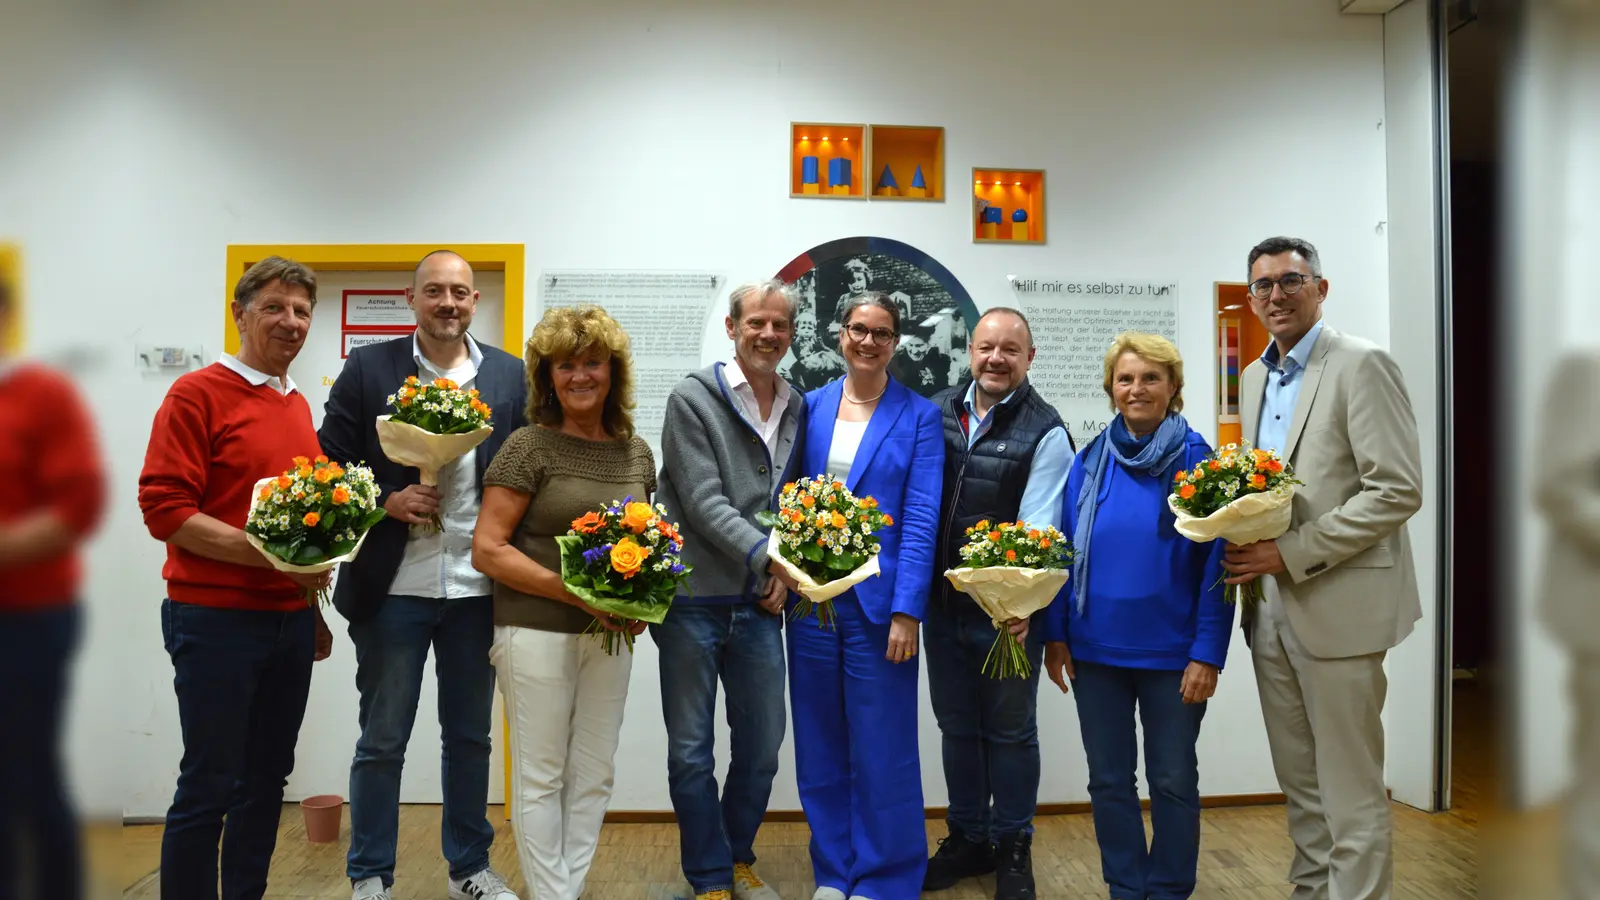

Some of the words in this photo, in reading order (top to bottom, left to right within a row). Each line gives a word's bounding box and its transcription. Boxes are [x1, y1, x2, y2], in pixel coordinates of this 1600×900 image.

[1041, 280, 1063, 293] mir
[1067, 283, 1082, 294] es
[1086, 281, 1124, 295] selbst
[1128, 284, 1143, 296] zu
[367, 298, 396, 306] Achtung
[1042, 307, 1072, 316] Haltung
[1103, 308, 1132, 316] Erzieher
[1143, 309, 1161, 317] nicht
[1044, 326, 1074, 335] Haltung
[1163, 328, 1176, 336] der
[1058, 354, 1074, 363] sagt
[1031, 362, 1053, 370] Doch
[1031, 371, 1047, 379] und
[1074, 372, 1092, 380] kann
[1046, 381, 1070, 389] Kindes
[1072, 381, 1095, 389] sehen
[1061, 390, 1076, 399] wird
[1078, 391, 1090, 399] ein
